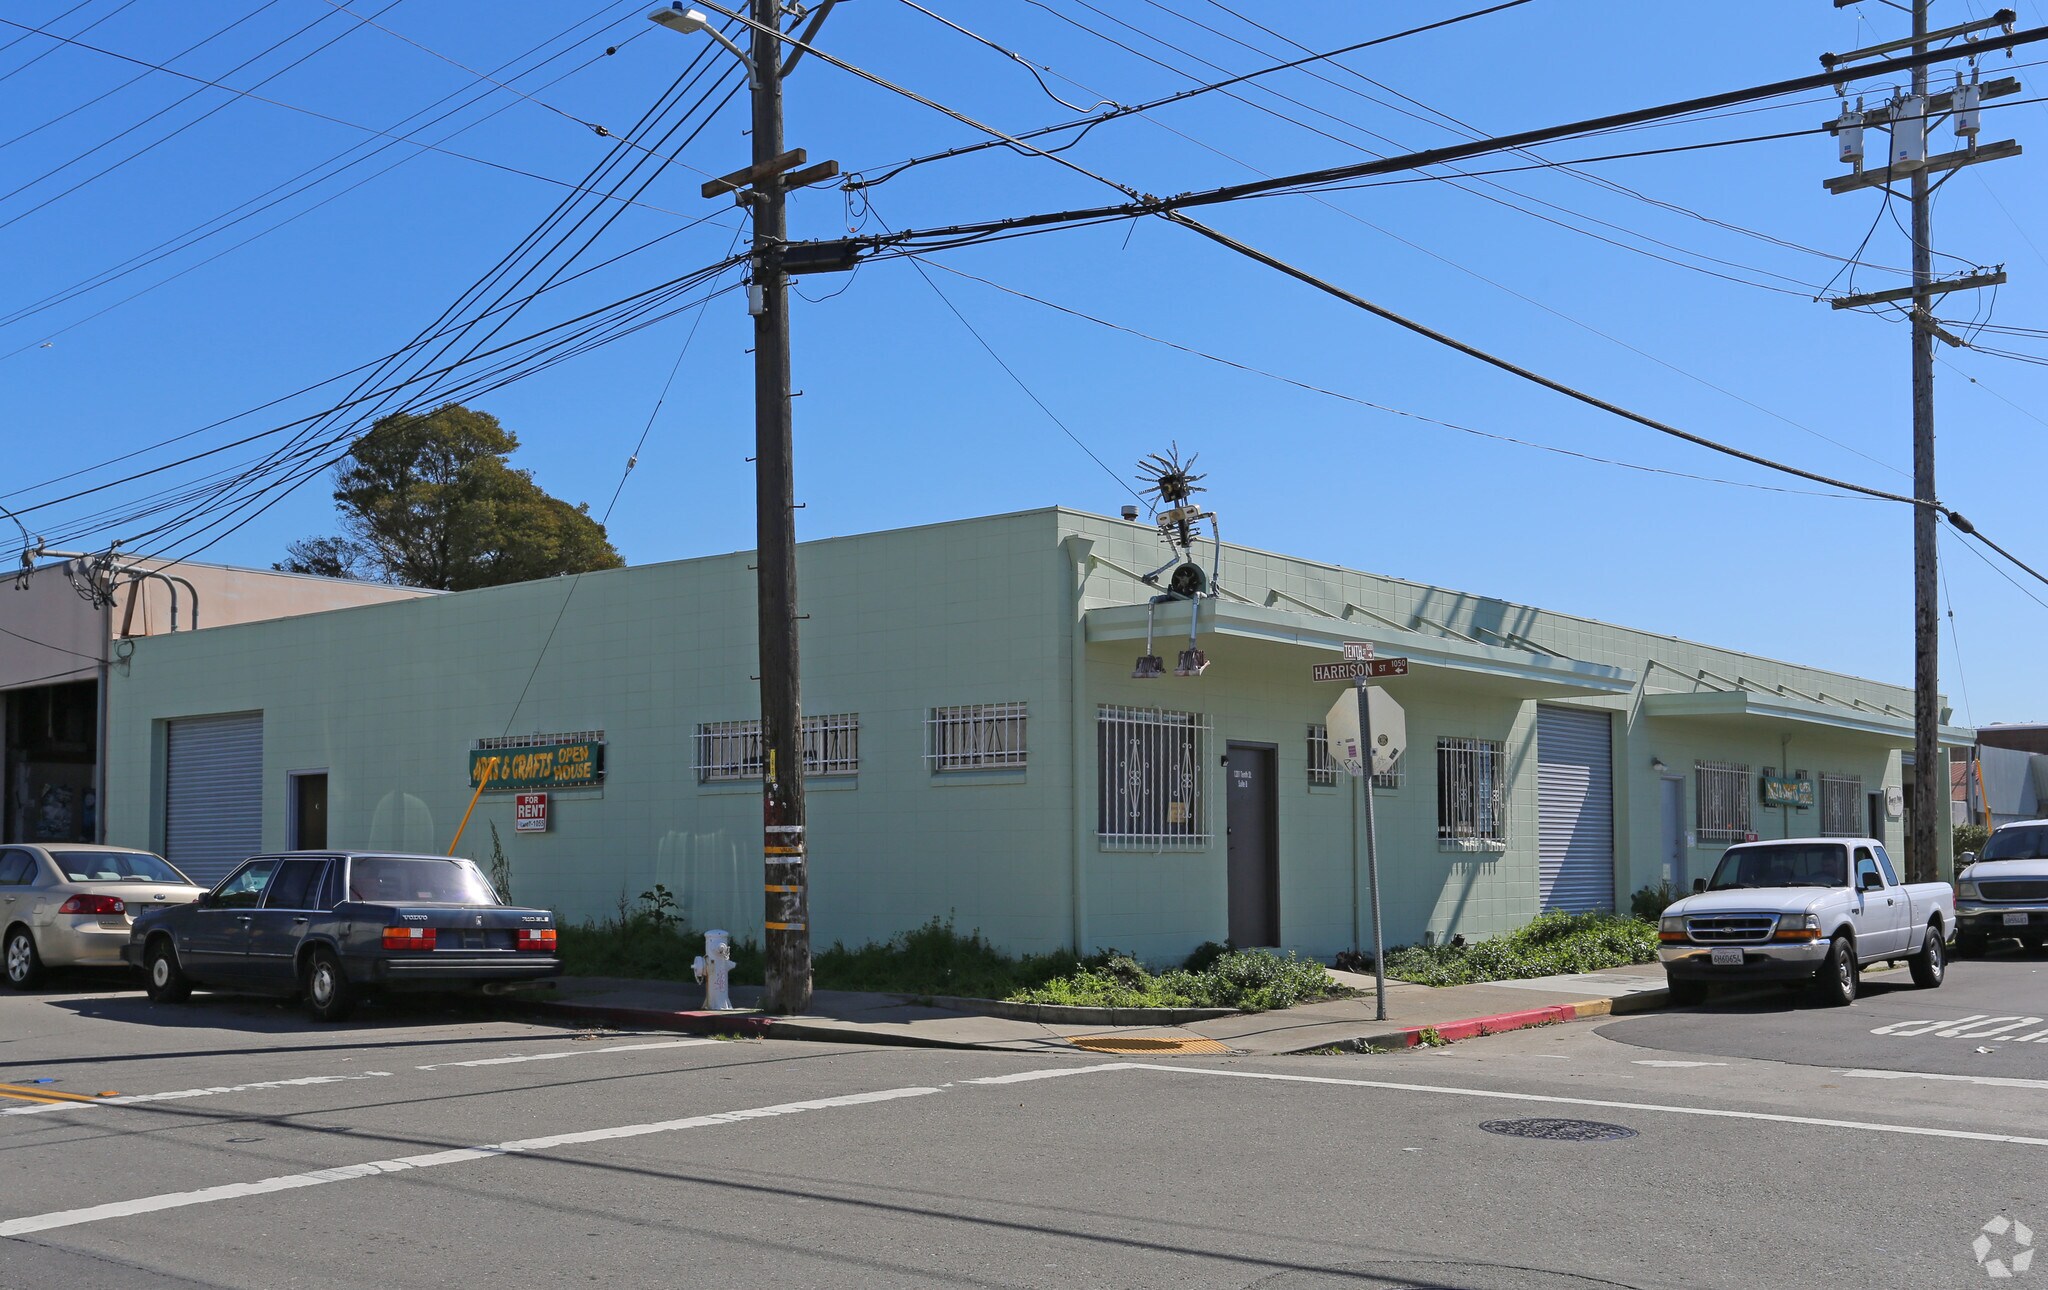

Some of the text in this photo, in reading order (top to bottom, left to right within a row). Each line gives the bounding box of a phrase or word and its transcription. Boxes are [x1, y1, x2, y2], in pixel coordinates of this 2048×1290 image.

[1344, 645, 1362, 658] TENTH
[1314, 659, 1406, 680] HARRISON ST 1050
[558, 746, 589, 763] OPEN
[501, 755, 511, 780] &
[512, 752, 553, 780] CRAFTS
[553, 762, 592, 781] HOUSE
[525, 796, 539, 804] FOR
[518, 804, 545, 818] RENT
